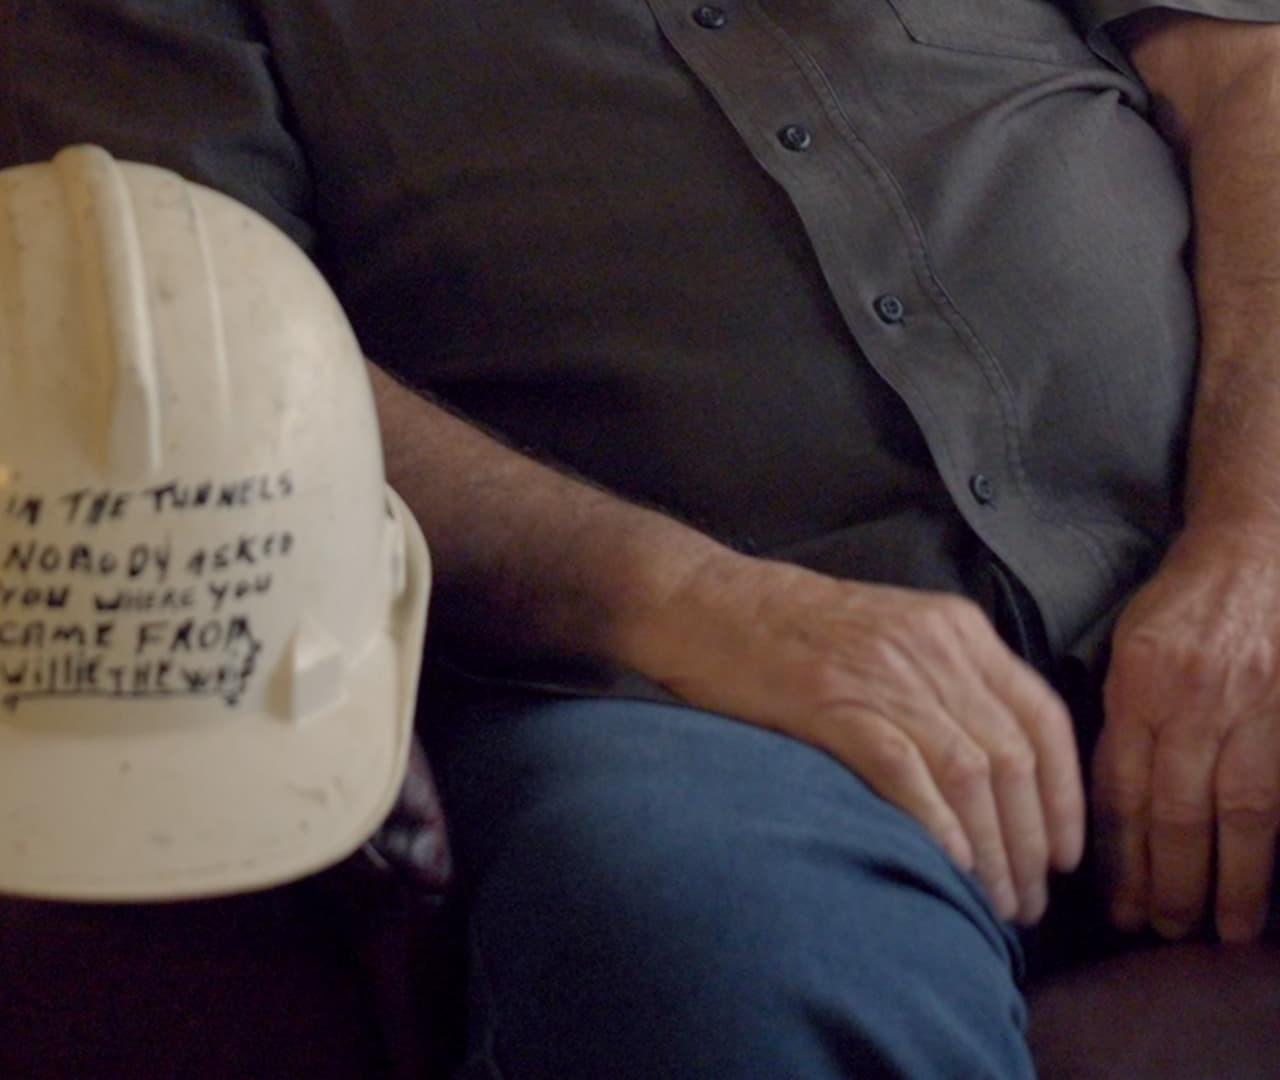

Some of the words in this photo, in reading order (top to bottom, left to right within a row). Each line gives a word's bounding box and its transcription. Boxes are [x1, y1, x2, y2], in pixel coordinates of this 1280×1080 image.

[60, 489, 127, 524] THE
[144, 472, 294, 514] TUNNELS
[94, 591, 195, 612] WHERE
[208, 574, 272, 610] YOU
